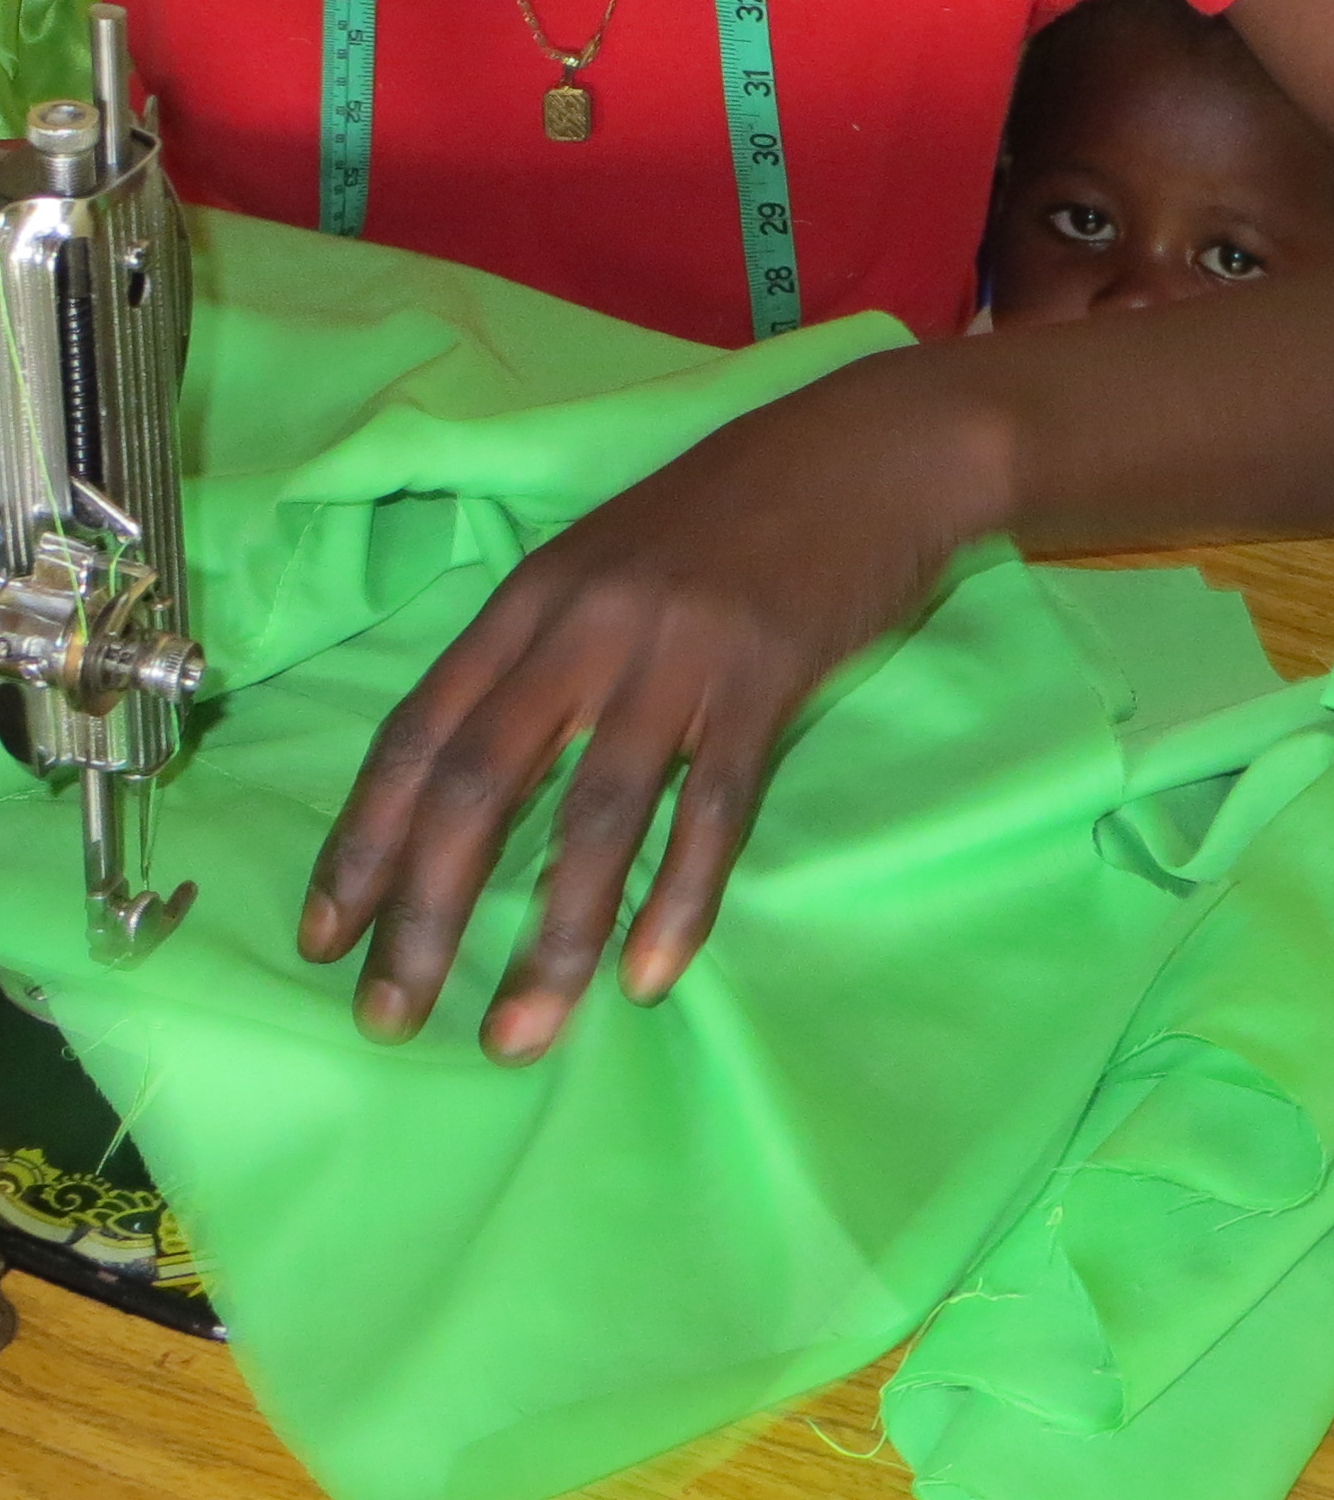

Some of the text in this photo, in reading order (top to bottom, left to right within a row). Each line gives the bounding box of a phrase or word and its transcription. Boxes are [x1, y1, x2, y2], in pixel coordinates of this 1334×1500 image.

[348, 29, 363, 46] 51
[742, 69, 771, 98] 31
[346, 100, 363, 124] 52
[749, 134, 780, 166] 30
[344, 167, 359, 188] 53
[757, 202, 788, 236] 29
[764, 265, 795, 296] 28
